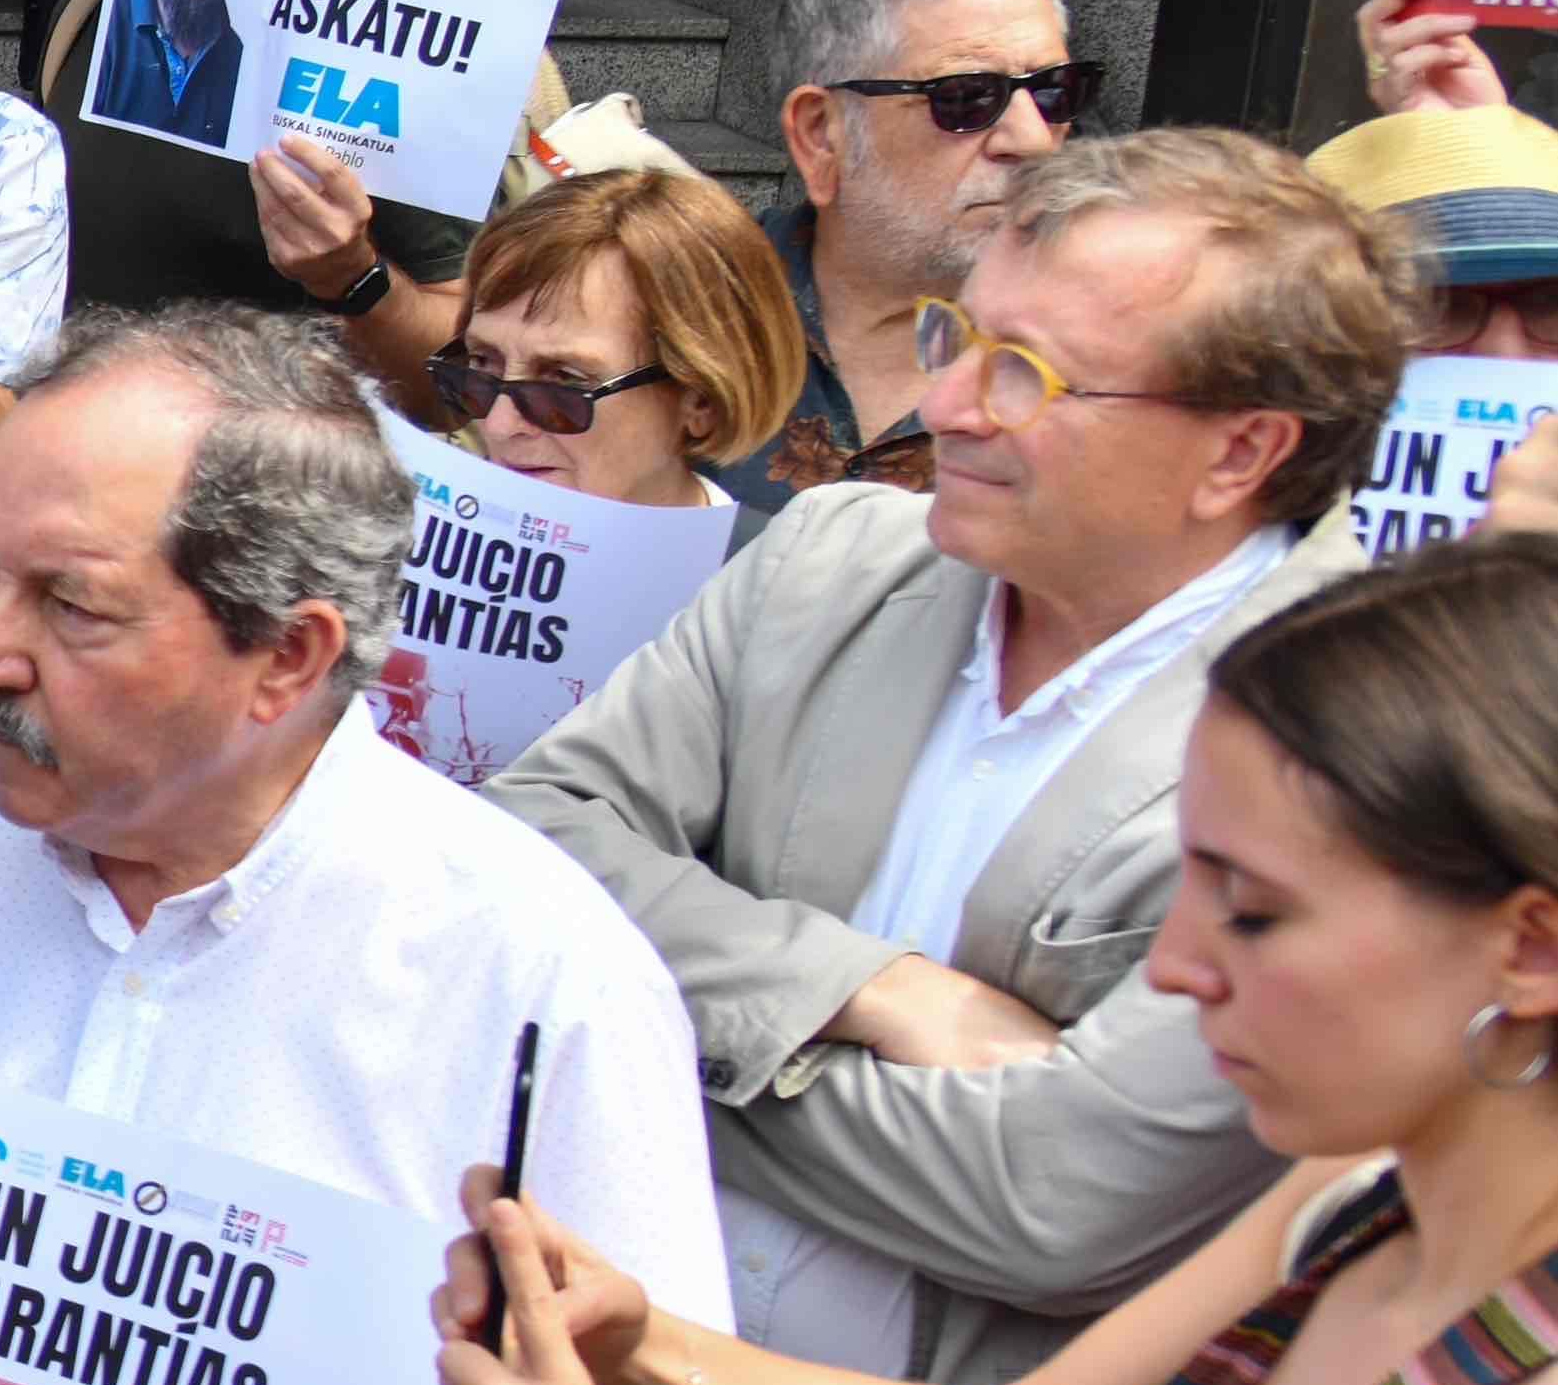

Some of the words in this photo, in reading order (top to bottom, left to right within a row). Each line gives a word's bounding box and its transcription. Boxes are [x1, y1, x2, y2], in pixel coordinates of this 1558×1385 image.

[277, 56, 401, 139] ELA
[315, 125, 395, 154] SINDIKATUA
[408, 514, 566, 604] JUICIO
[396, 579, 569, 664] ANTÍAS
[60, 1155, 126, 1199] ELA
[59, 1207, 277, 1344] JUICIO
